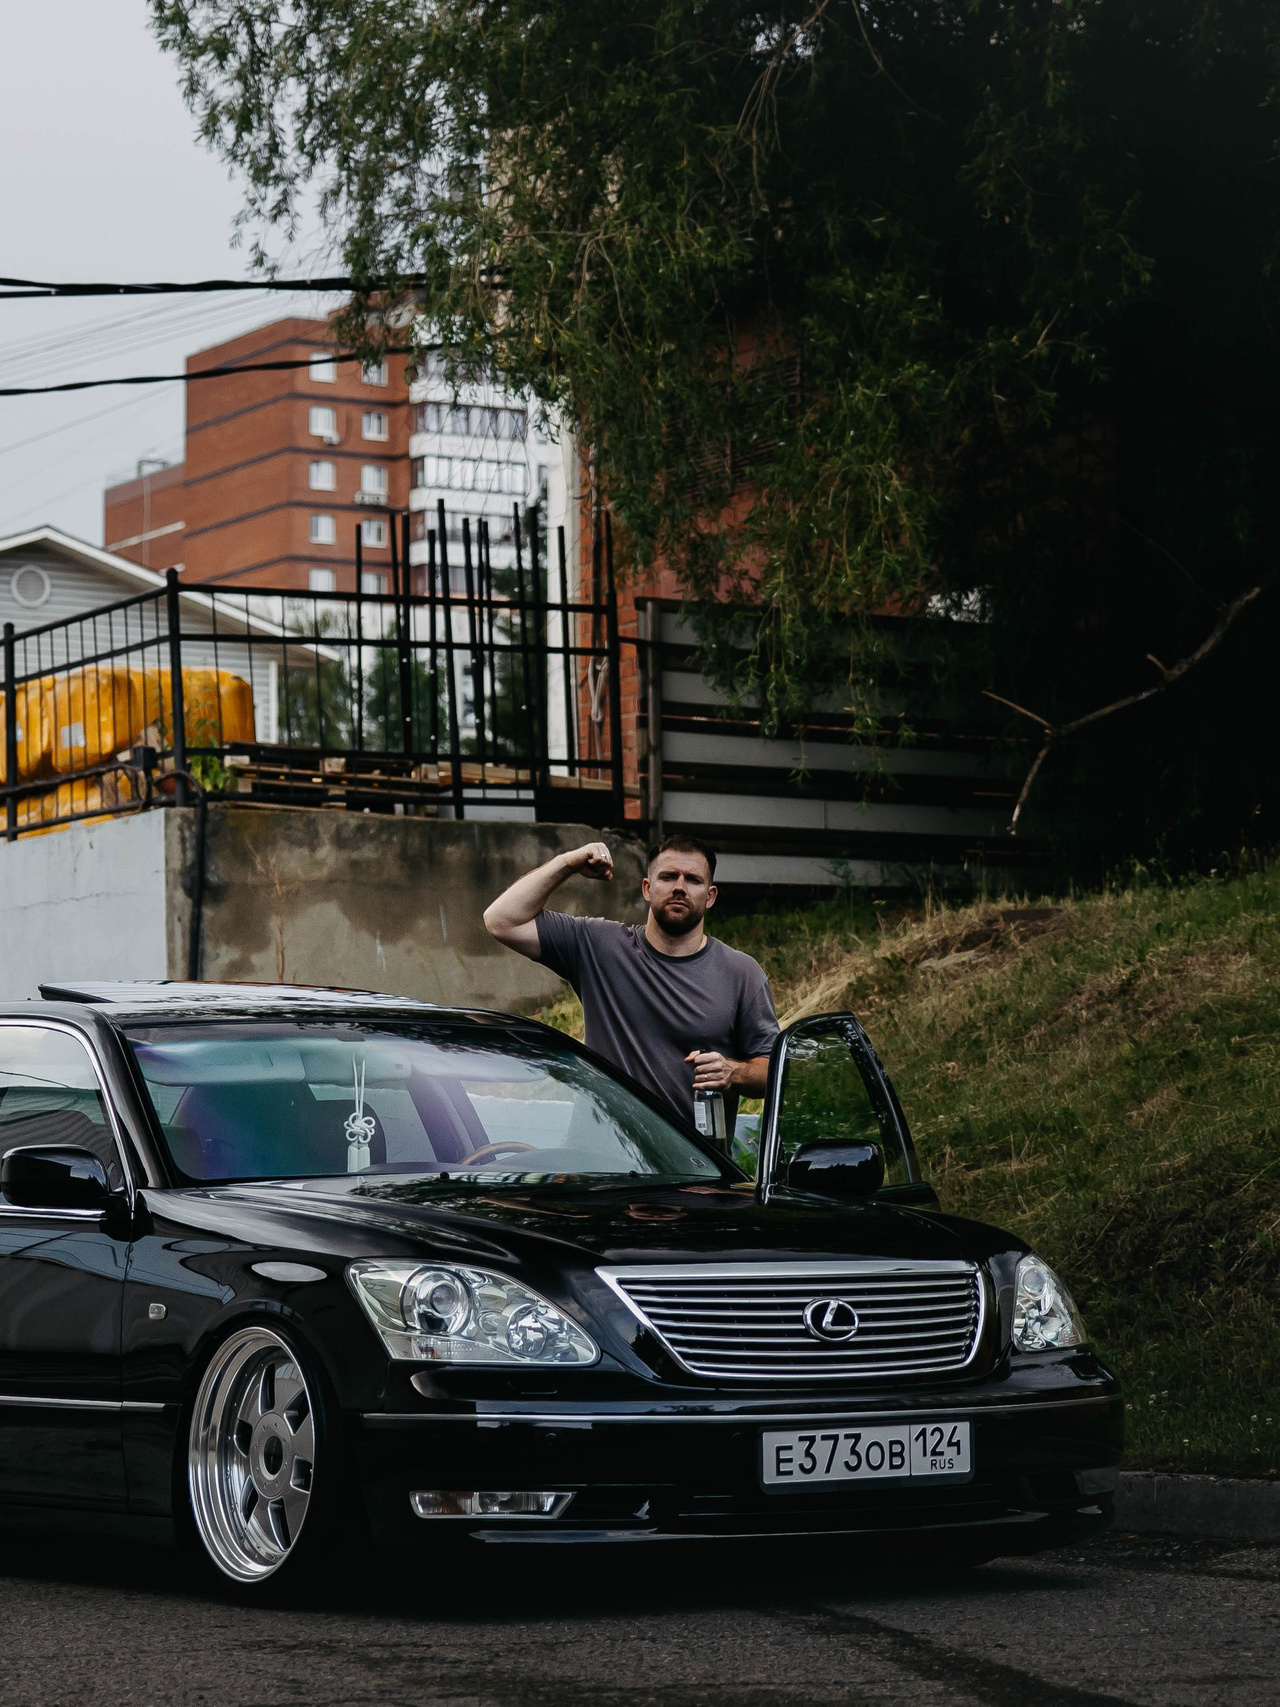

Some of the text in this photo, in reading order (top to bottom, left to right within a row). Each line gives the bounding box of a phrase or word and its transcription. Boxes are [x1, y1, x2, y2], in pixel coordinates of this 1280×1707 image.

[775, 1425, 961, 1476] E373OB 124
[930, 1458, 954, 1470] RUS
